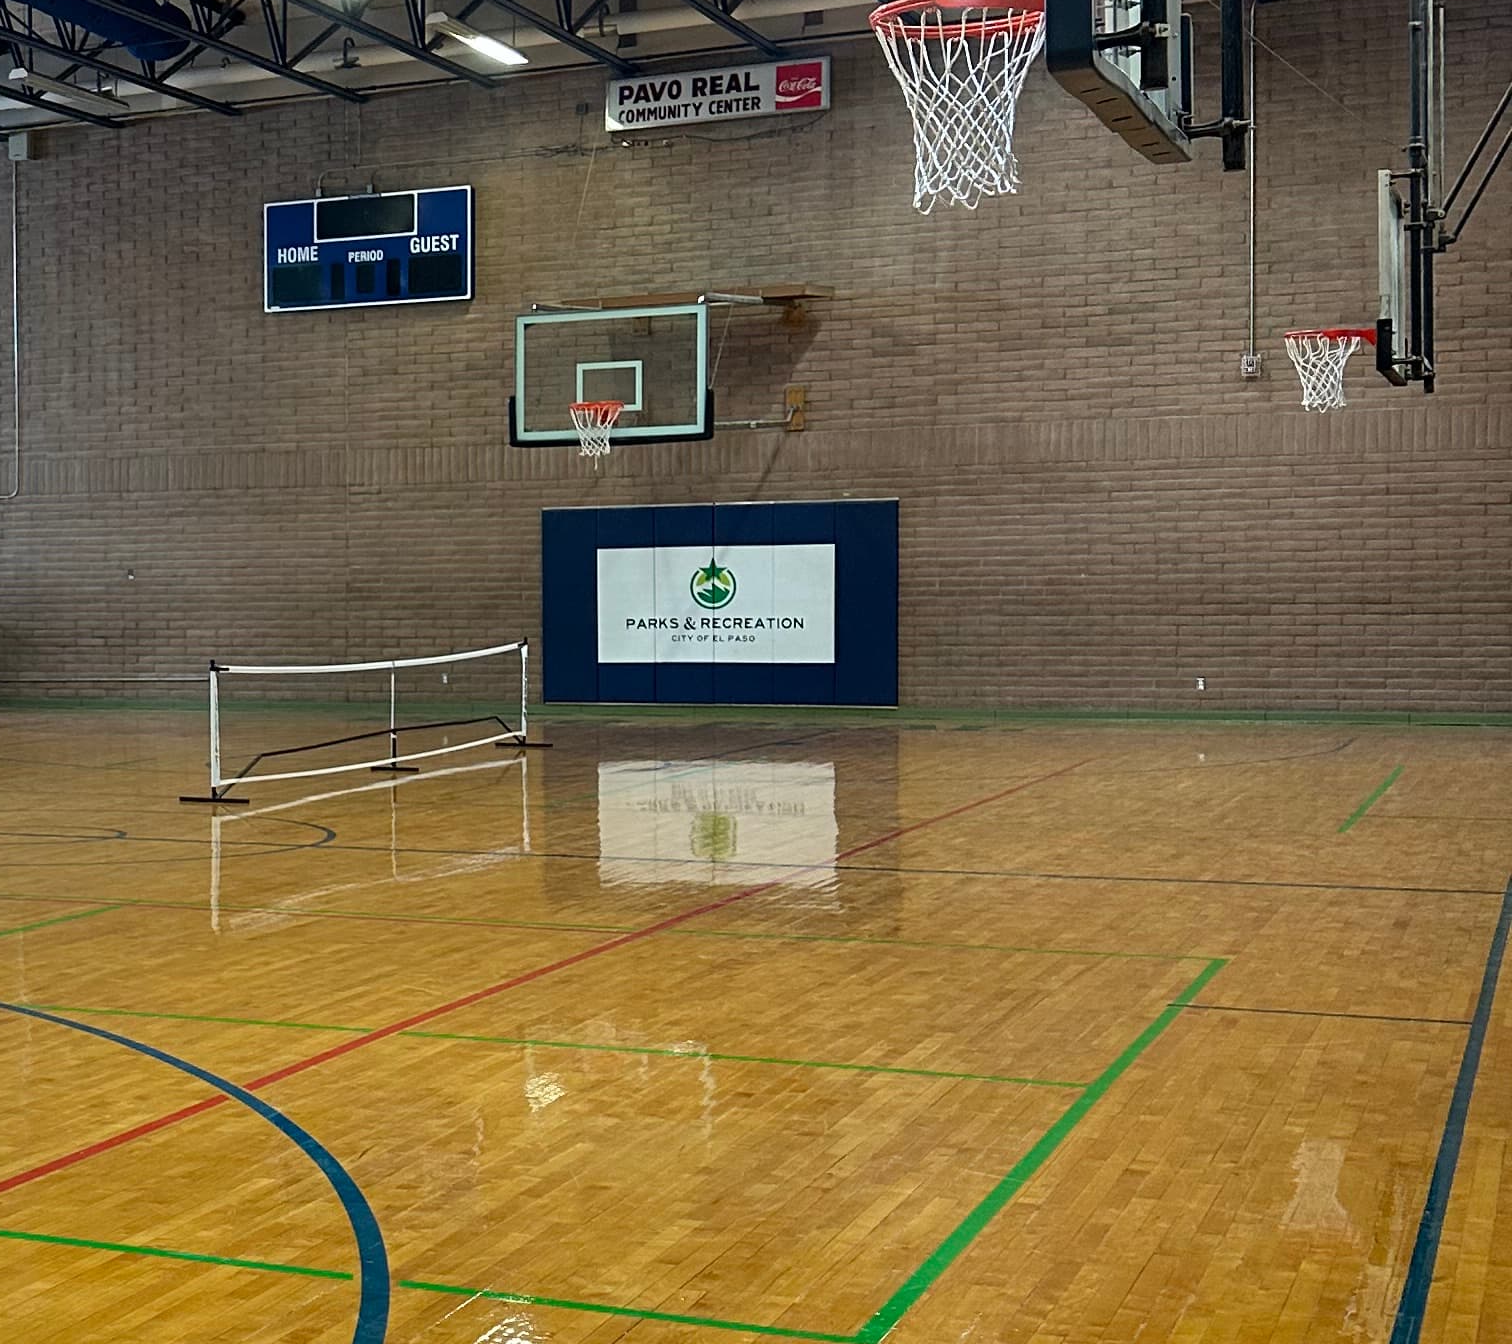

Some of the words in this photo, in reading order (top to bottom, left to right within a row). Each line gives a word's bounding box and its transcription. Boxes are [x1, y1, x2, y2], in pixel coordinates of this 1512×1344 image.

[618, 79, 682, 106] PAVO
[691, 71, 761, 97] REAL
[618, 102, 704, 124] COMMUNITY
[708, 96, 761, 116] CENTER
[410, 234, 460, 254] GUEST
[277, 246, 319, 264] HOME
[348, 250, 384, 263] PERIOD
[625, 617, 679, 630] PARKS
[683, 616, 697, 631] &
[700, 616, 805, 630] RECREATION
[671, 634, 693, 643] CITY
[696, 634, 709, 643] OF
[712, 634, 725, 643] EL
[727, 634, 756, 643] PASO
